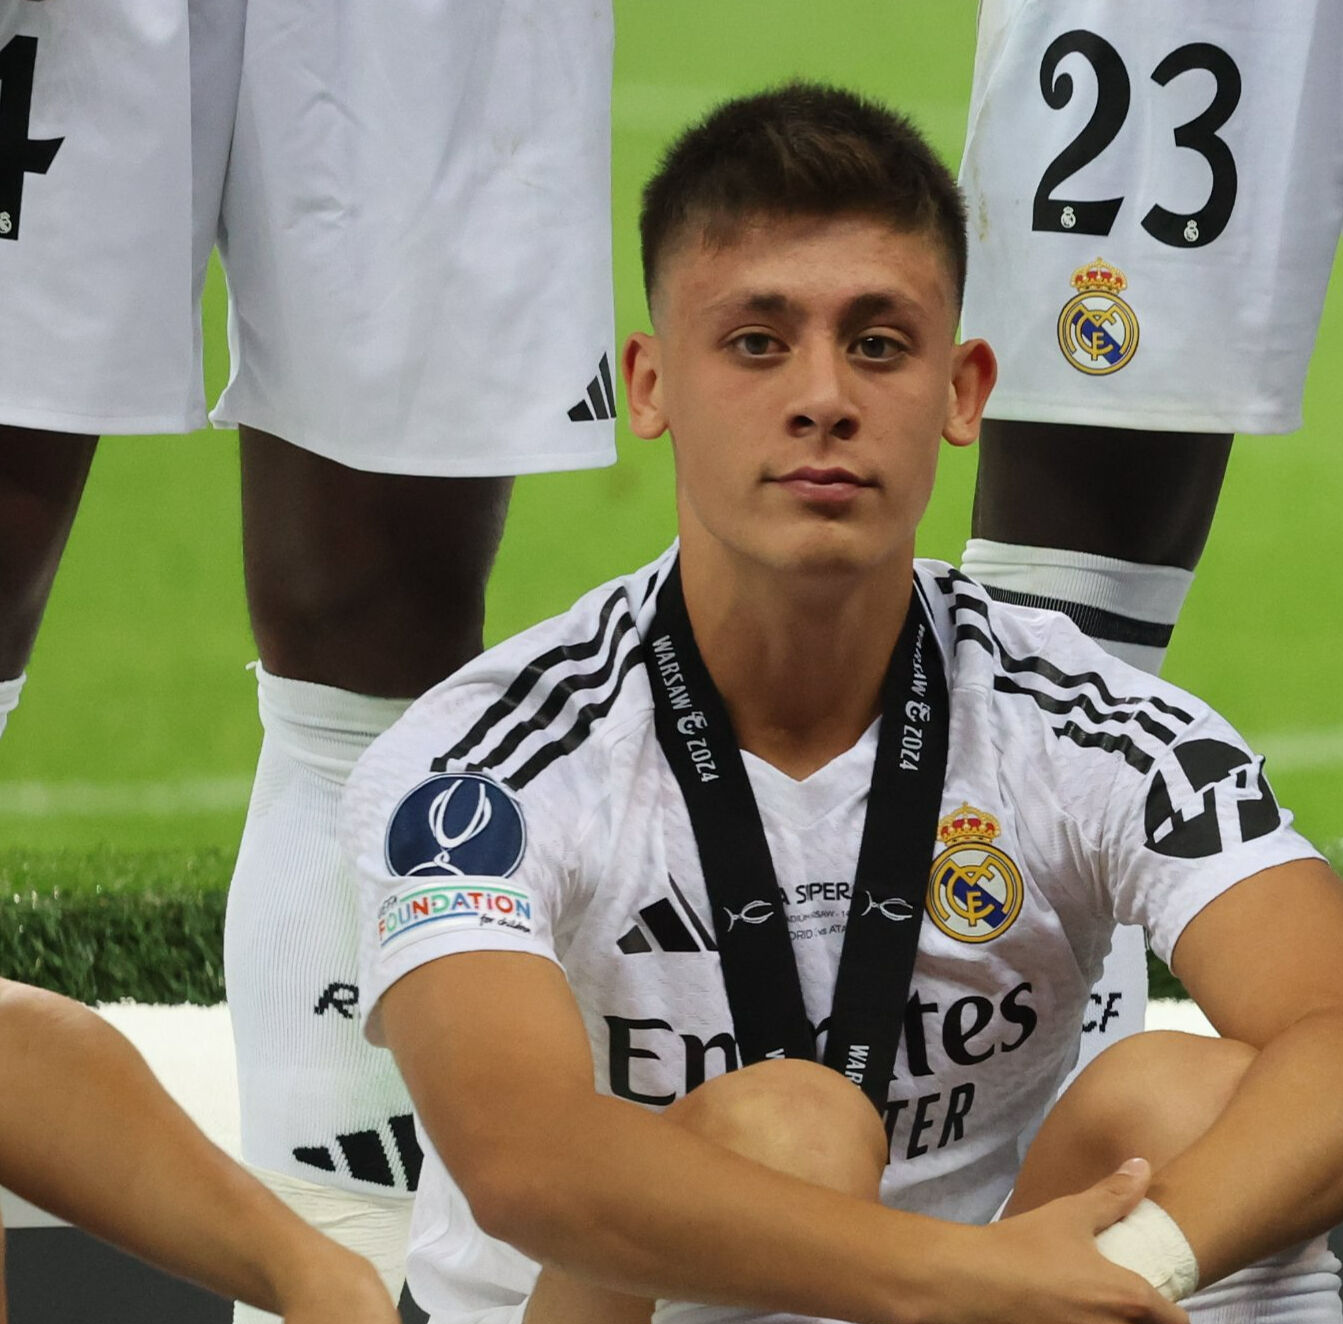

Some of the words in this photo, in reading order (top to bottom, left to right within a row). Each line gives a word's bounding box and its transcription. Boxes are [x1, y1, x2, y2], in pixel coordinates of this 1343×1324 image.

[1032, 29, 1242, 249] 23
[652, 634, 693, 710] WARSAW
[686, 738, 719, 782] 2024
[900, 725, 923, 771] 2024
[378, 892, 531, 938] FOUNDATION
